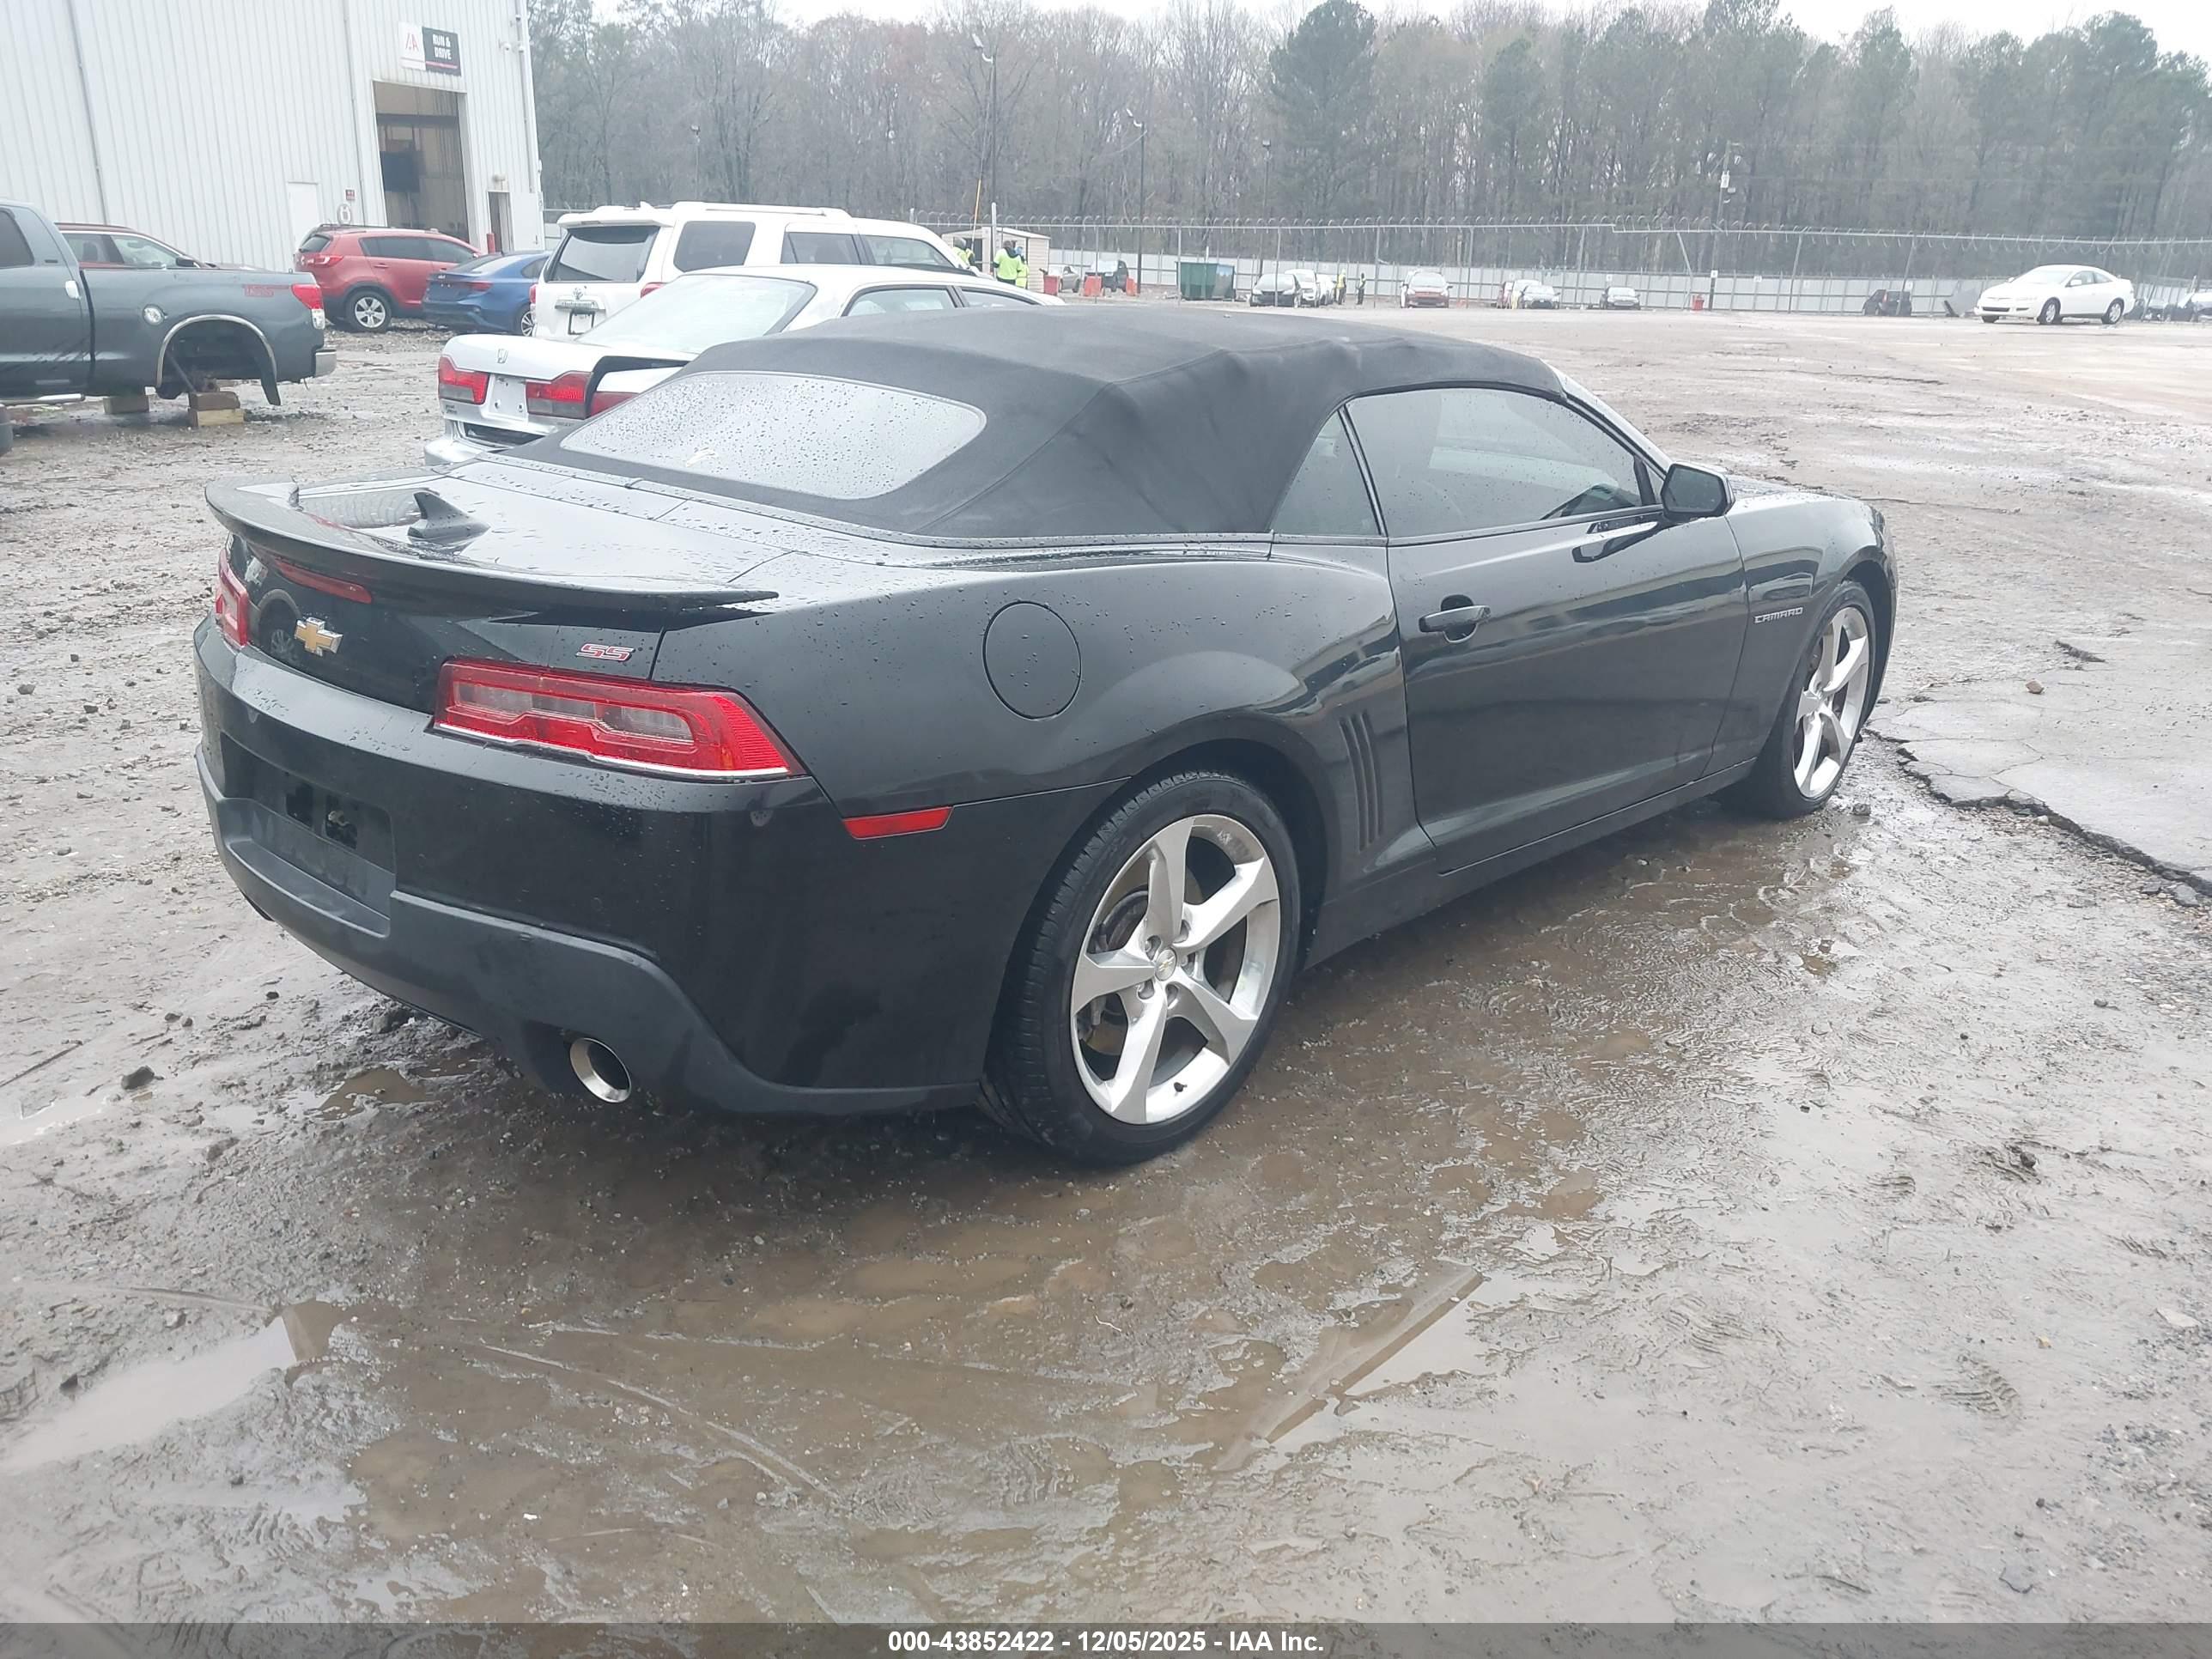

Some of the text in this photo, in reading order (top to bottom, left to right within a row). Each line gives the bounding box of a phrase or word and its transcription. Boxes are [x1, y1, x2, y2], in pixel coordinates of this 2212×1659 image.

[432, 33, 451, 47] RUN &
[434, 46, 452, 60] DRIVE
[1754, 606, 1803, 623] CAMARO
[576, 643, 635, 661] SS
